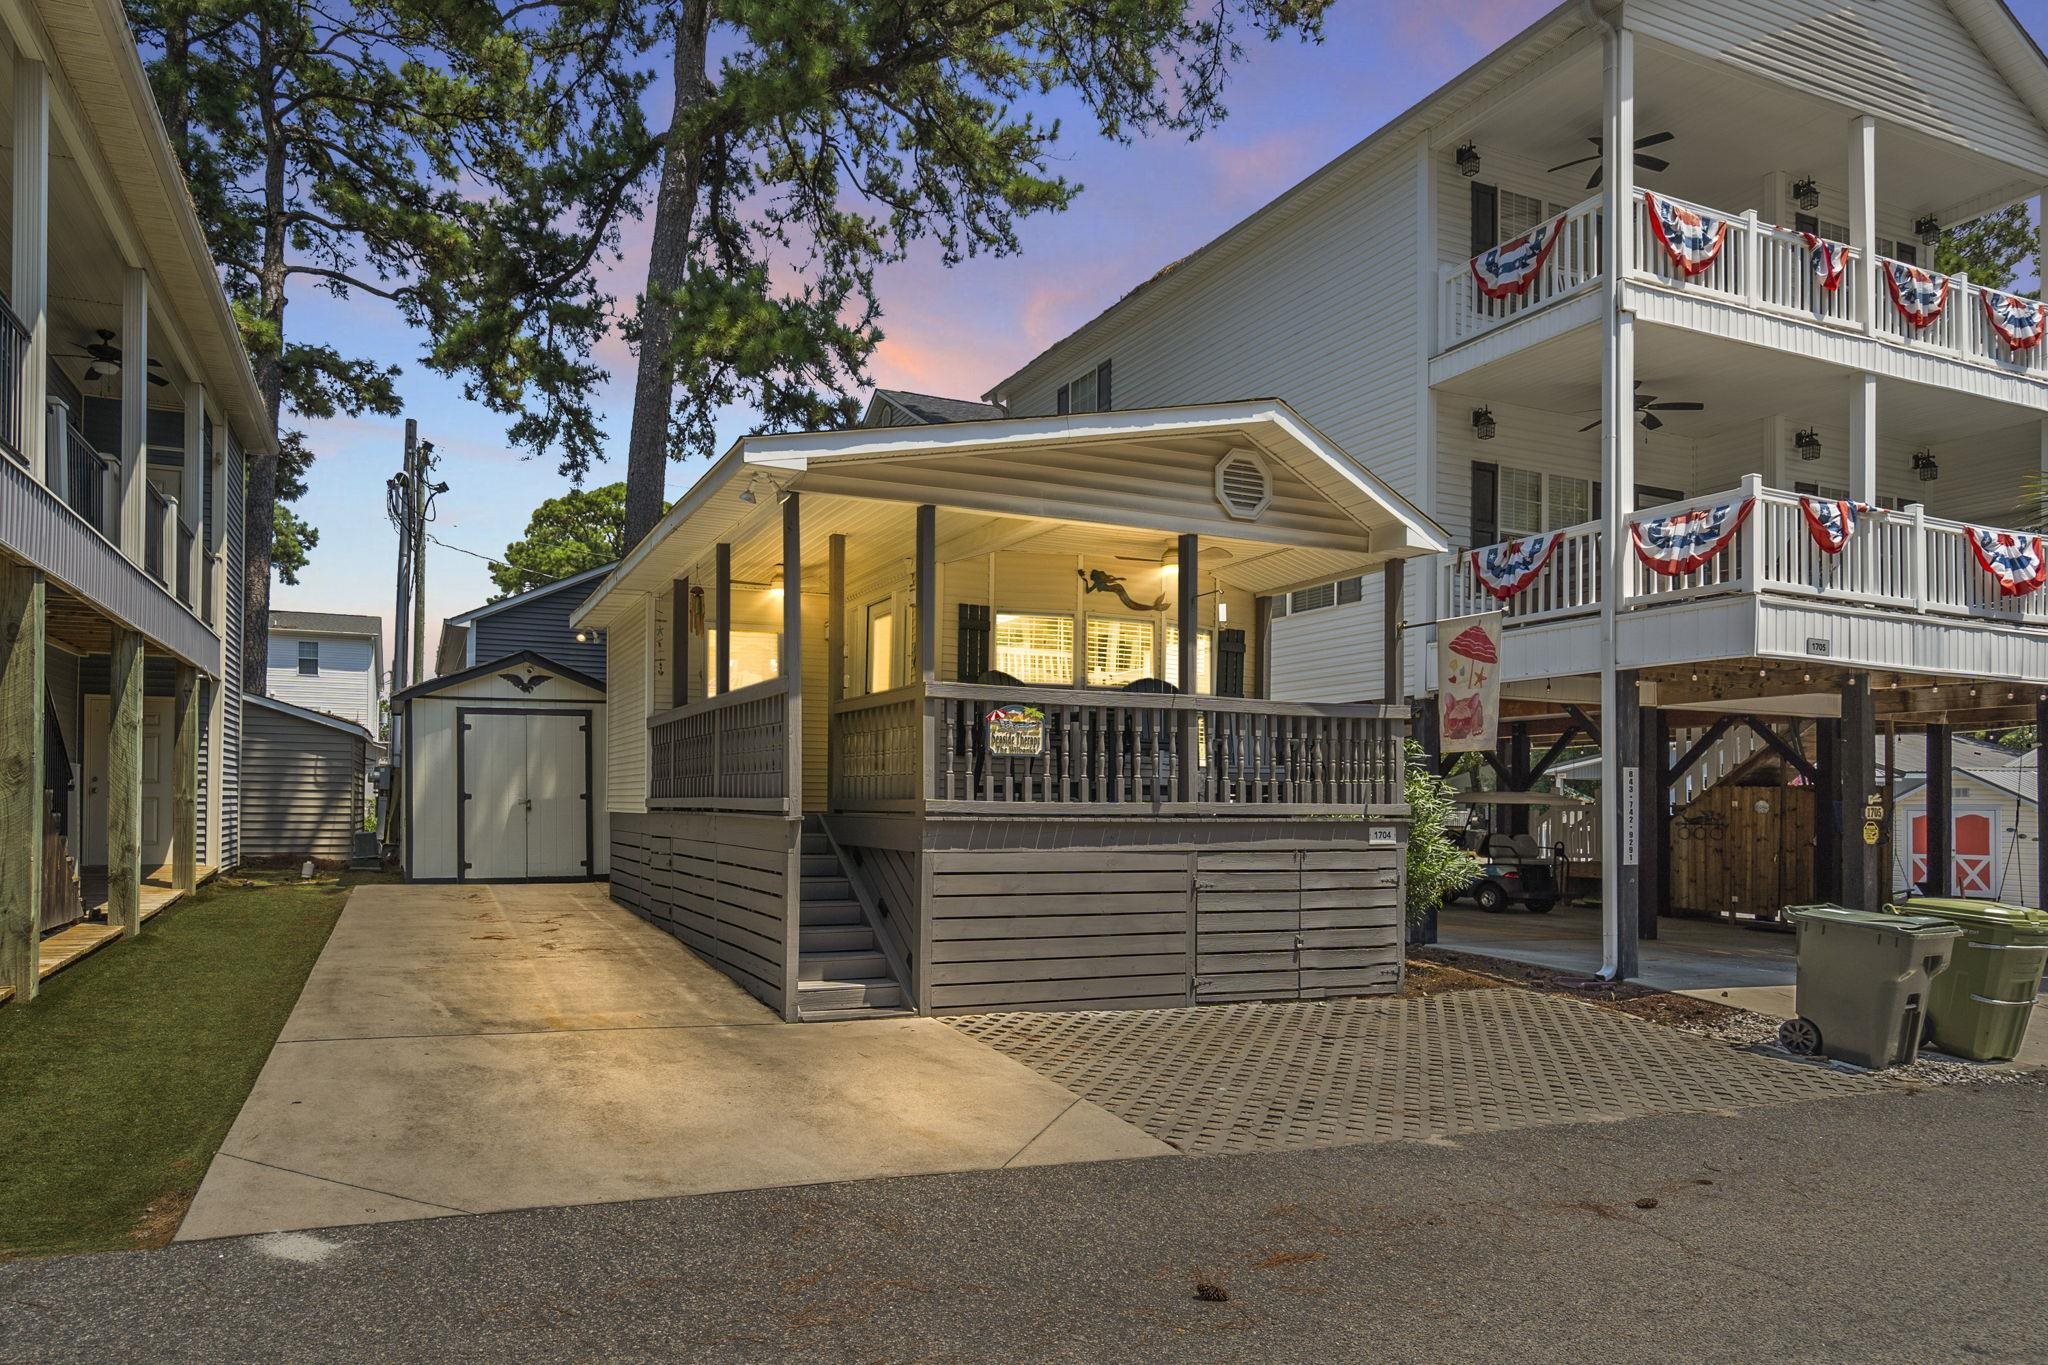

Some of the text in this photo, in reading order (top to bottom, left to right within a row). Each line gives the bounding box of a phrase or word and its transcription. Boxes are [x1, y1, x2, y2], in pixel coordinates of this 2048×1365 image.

[1812, 642, 1826, 652] 1705
[991, 732, 1041, 750] Seaside Therapy
[1867, 807, 1882, 818] 1705
[1374, 830, 1392, 840] 1704
